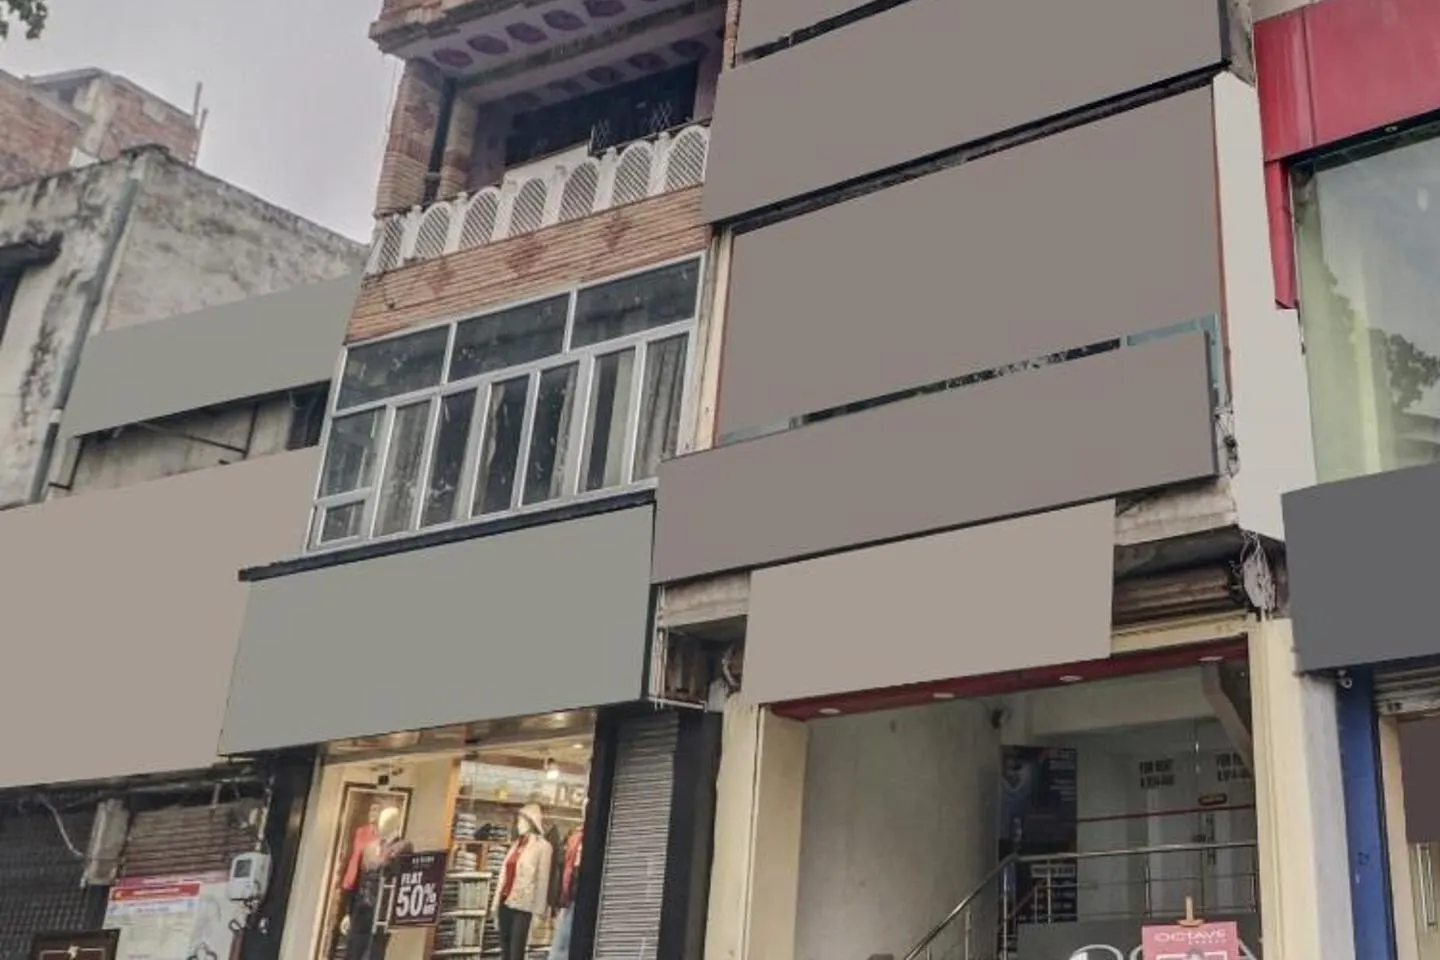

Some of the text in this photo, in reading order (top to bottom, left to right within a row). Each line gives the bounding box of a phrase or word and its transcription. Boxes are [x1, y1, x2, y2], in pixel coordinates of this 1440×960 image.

[400, 871, 423, 885] FLAT
[395, 883, 437, 917] 50%
[1153, 929, 1227, 943] OCTAVE
